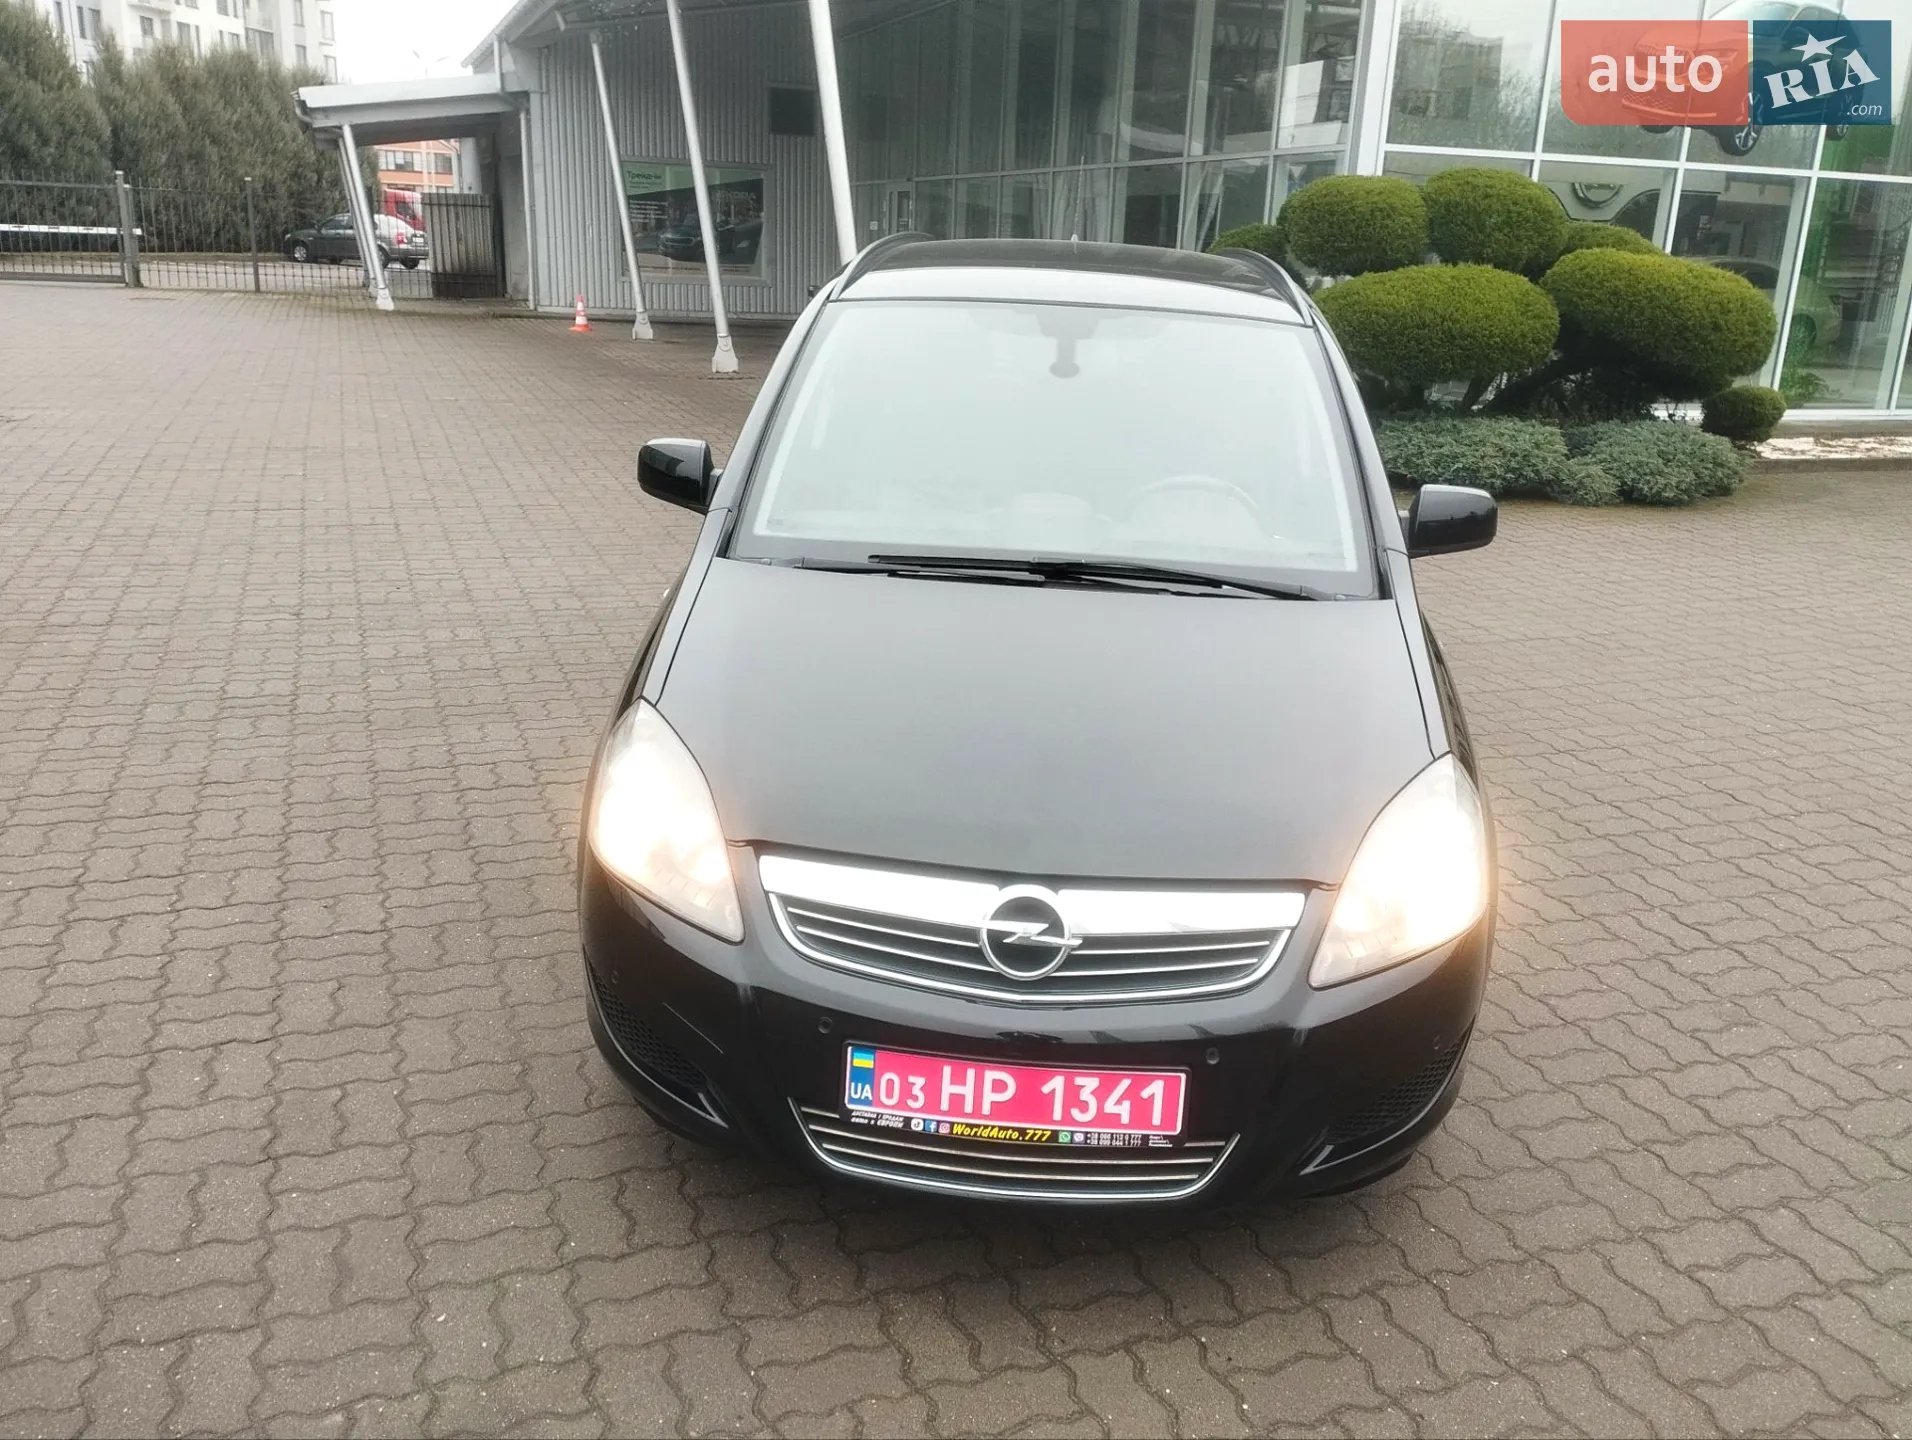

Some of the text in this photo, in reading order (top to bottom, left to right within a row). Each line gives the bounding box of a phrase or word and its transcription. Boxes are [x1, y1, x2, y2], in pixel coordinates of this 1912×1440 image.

[850, 1082, 873, 1100] UA
[879, 1065, 1164, 1126] 03 HP 1341
[952, 1123, 1052, 1141] WorldAuto.777
